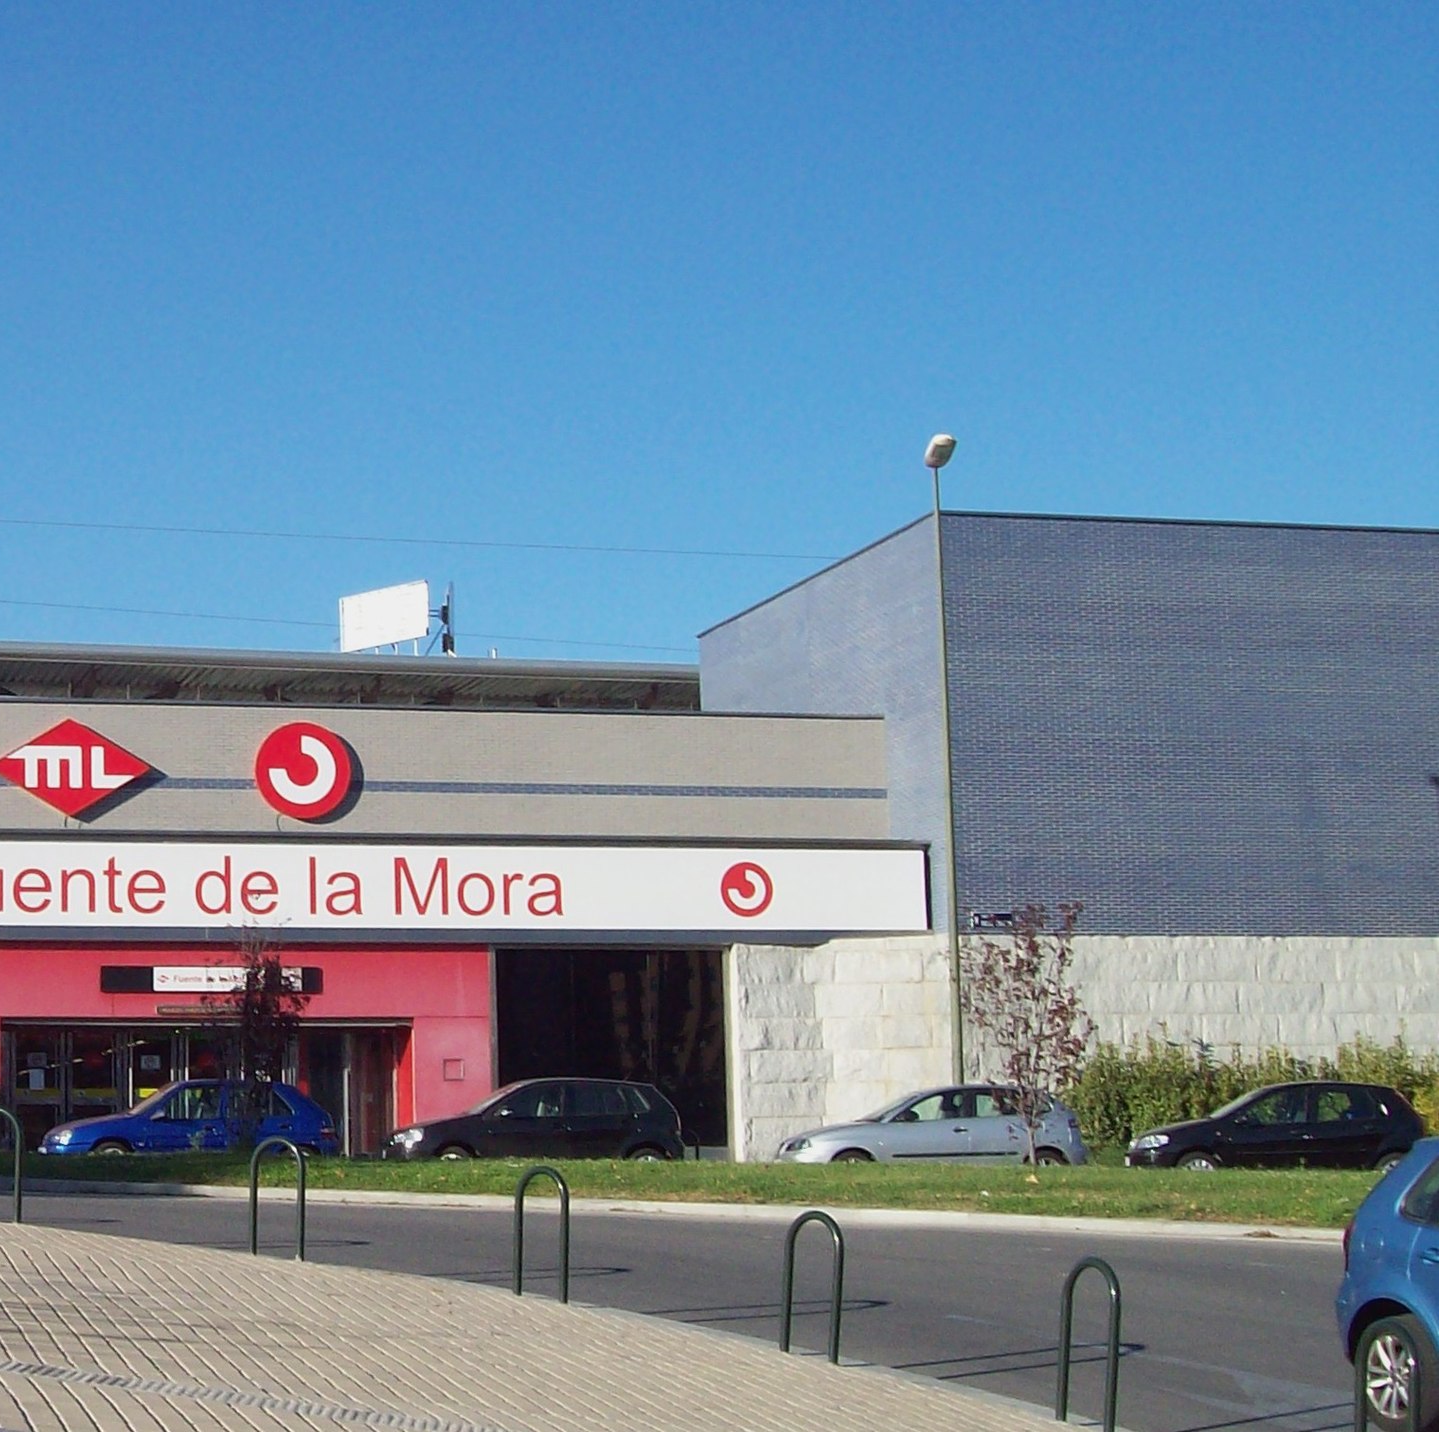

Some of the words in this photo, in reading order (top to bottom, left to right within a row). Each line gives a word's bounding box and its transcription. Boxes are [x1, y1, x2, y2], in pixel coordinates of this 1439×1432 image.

[195, 856, 279, 915] de
[309, 857, 363, 916] la
[393, 856, 563, 916] Mora
